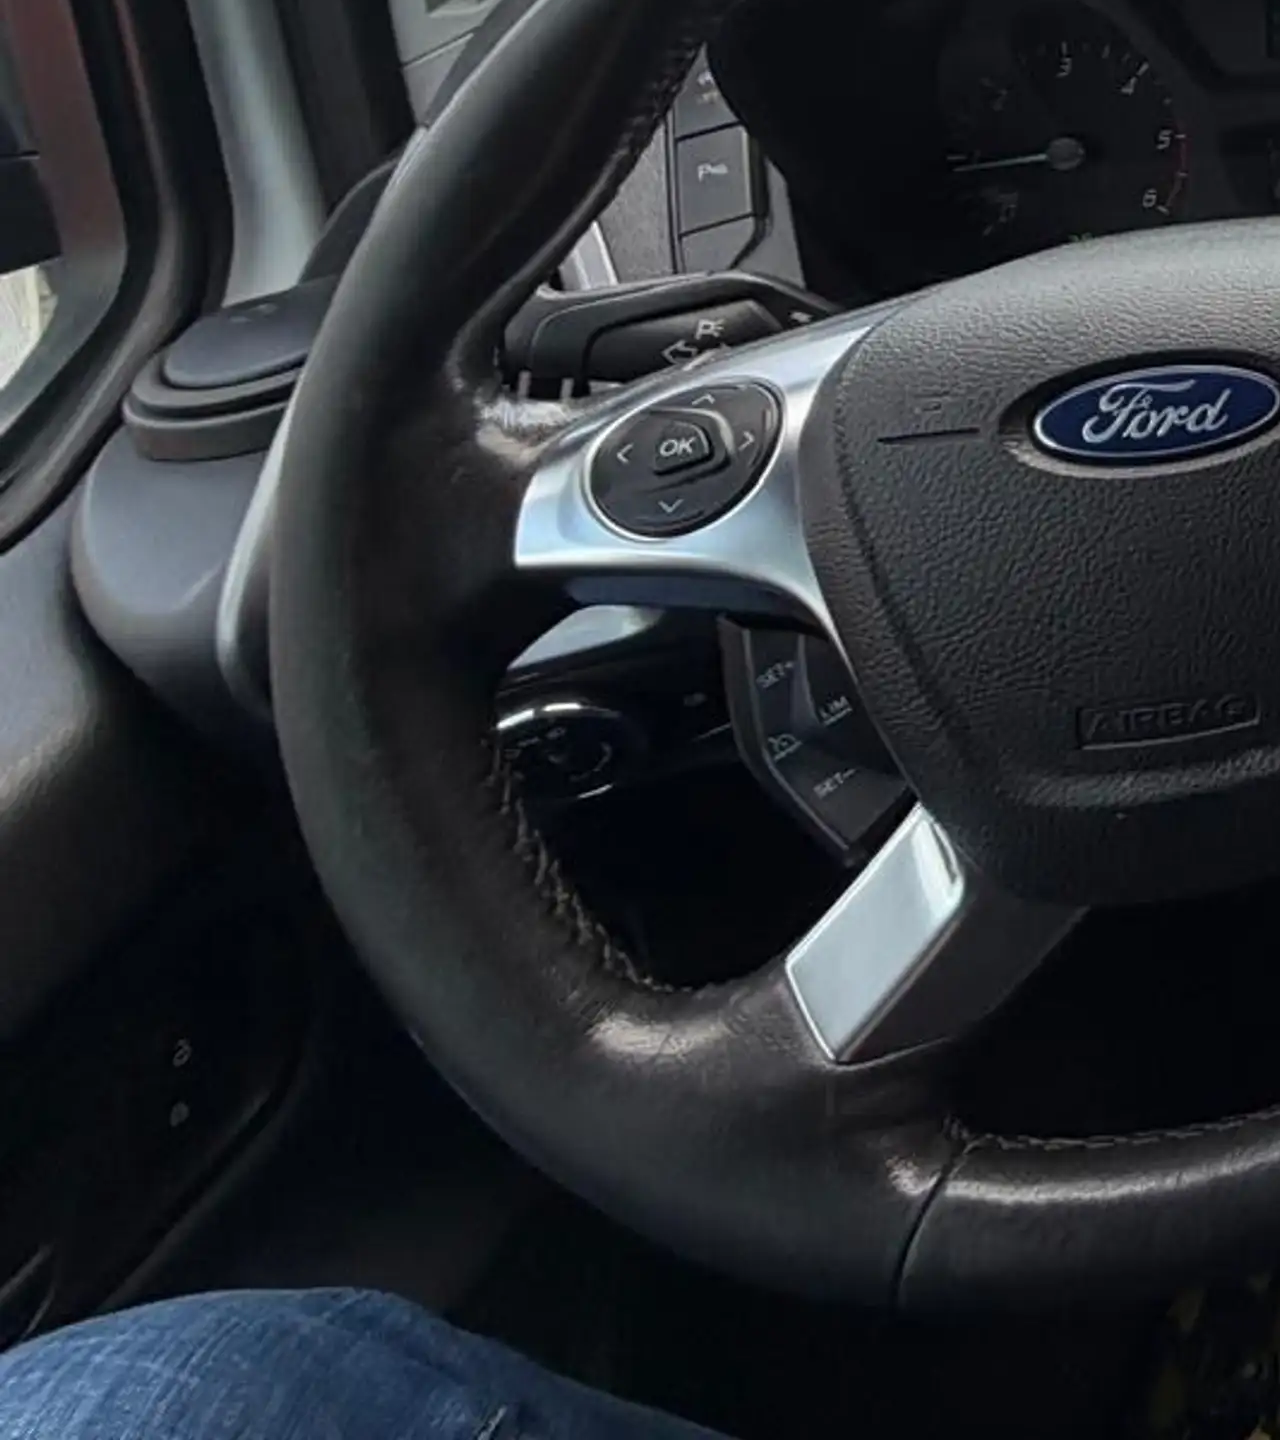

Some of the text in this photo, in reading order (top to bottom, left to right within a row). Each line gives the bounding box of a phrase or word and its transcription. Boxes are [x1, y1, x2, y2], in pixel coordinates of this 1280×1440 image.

[1156, 129, 1172, 149] 5
[1082, 380, 1232, 443] Ford
[660, 437, 696, 457] OK
[1084, 694, 1247, 740] AIRBAG
